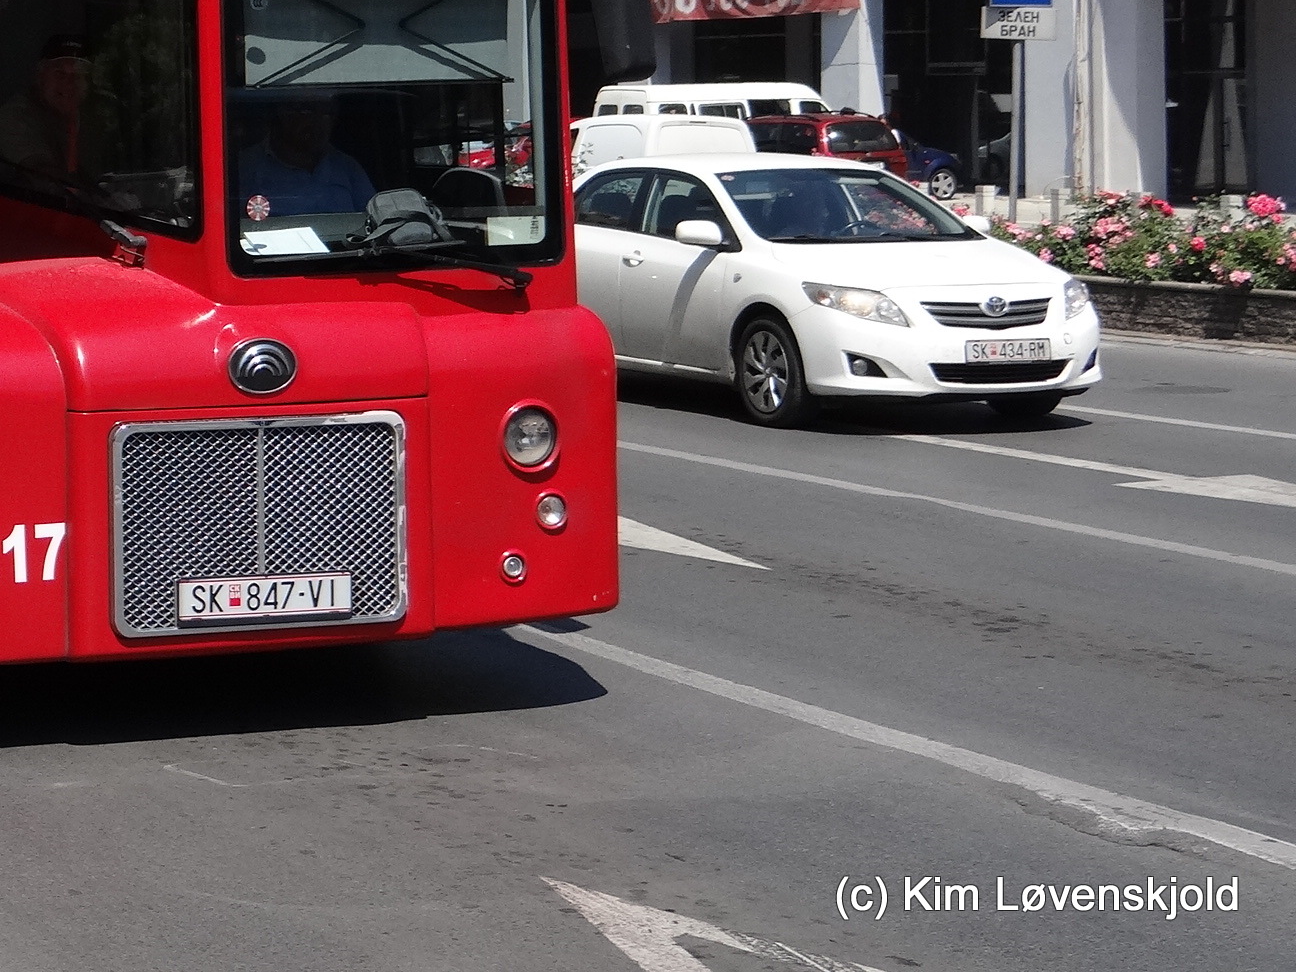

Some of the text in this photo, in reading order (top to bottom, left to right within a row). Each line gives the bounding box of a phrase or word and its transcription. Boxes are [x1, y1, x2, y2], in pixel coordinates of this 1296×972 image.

[997, 10, 1040, 24] ЗЕЛЕН
[1000, 24, 1036, 38] БРАН
[972, 341, 1045, 359] SK 434-RM
[191, 579, 335, 614] SK 847-VI
